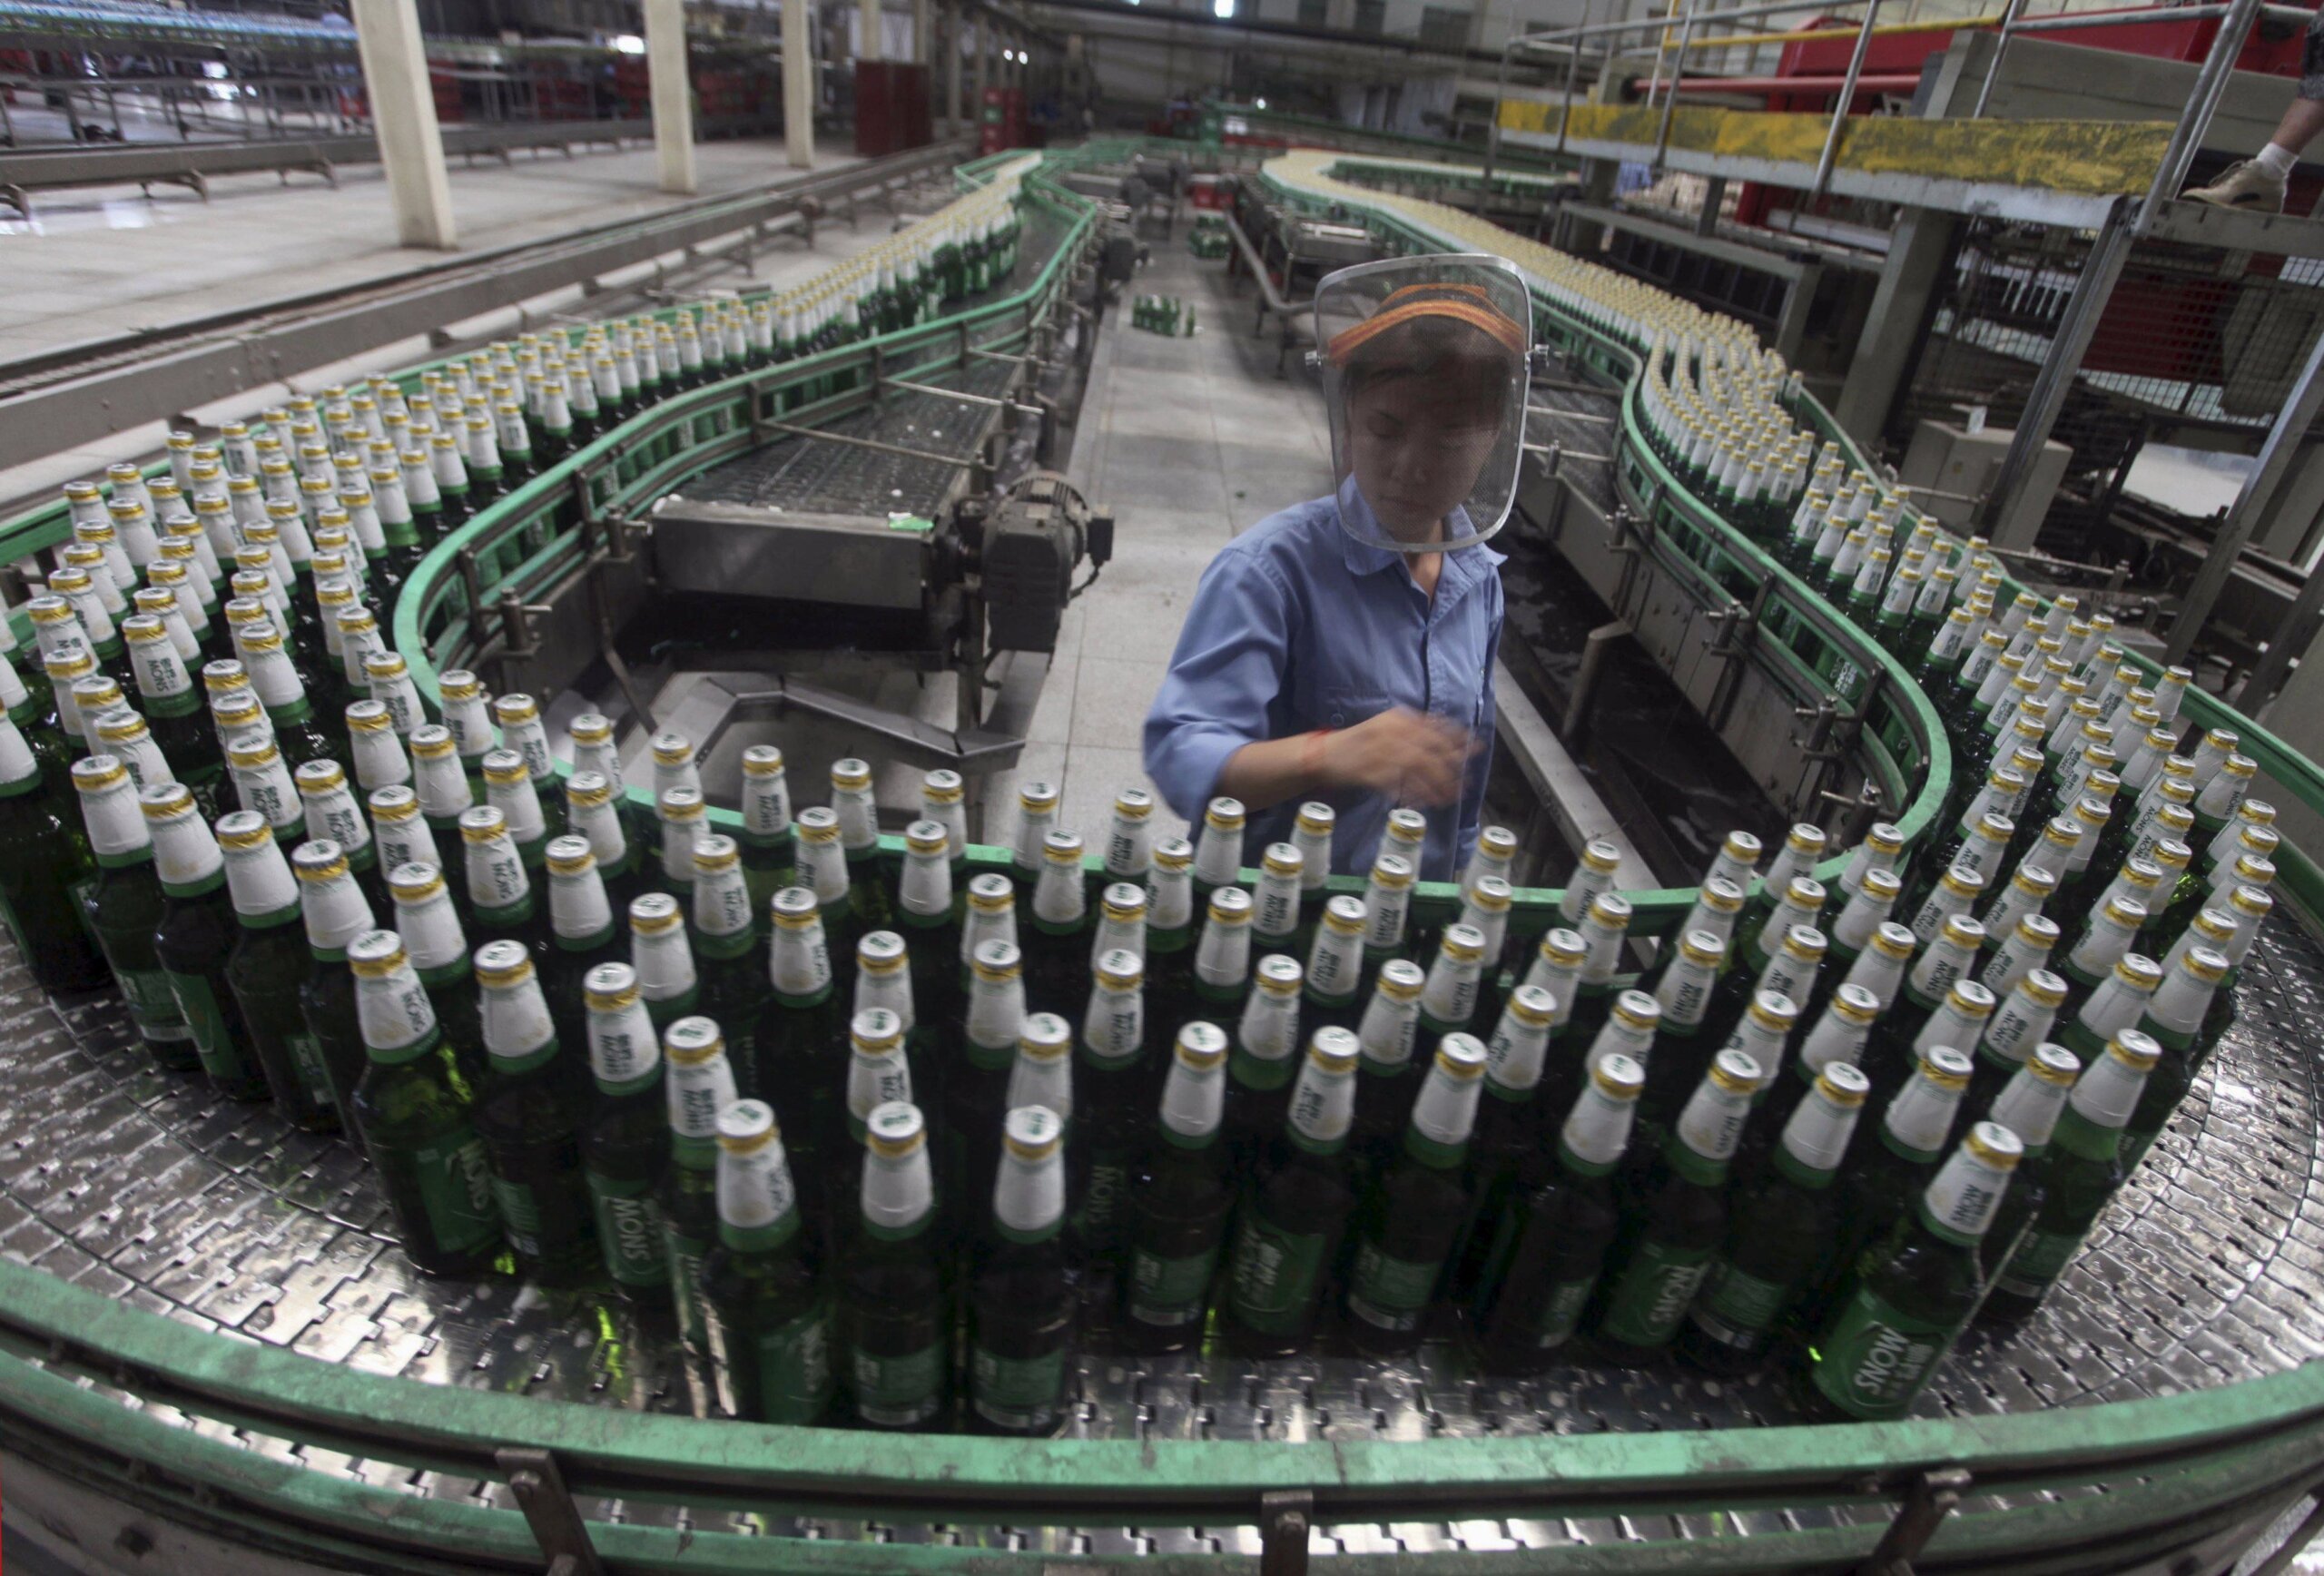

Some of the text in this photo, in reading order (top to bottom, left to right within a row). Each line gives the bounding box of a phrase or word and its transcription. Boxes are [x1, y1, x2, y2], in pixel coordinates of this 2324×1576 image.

[148, 657, 168, 694] SNOW
[1832, 661, 1853, 692] SNO
[1993, 698, 2009, 723] SNOW
[2058, 746, 2076, 772] SNOW
[2134, 805, 2154, 833] SNOW
[2223, 790, 2240, 816] SNOW
[2133, 833, 2153, 859] NOW
[1925, 960, 1947, 992] SNOW
[1671, 981, 1694, 1018] SNOW
[1992, 1010, 2015, 1044] SNOW
[1088, 1165, 1119, 1222] SNOW
[1952, 1184, 1976, 1224] SNOW
[614, 1197, 647, 1262] SNOW
[1649, 1263, 1698, 1325] SNOW
[1854, 1326, 1911, 1395] SNOW
